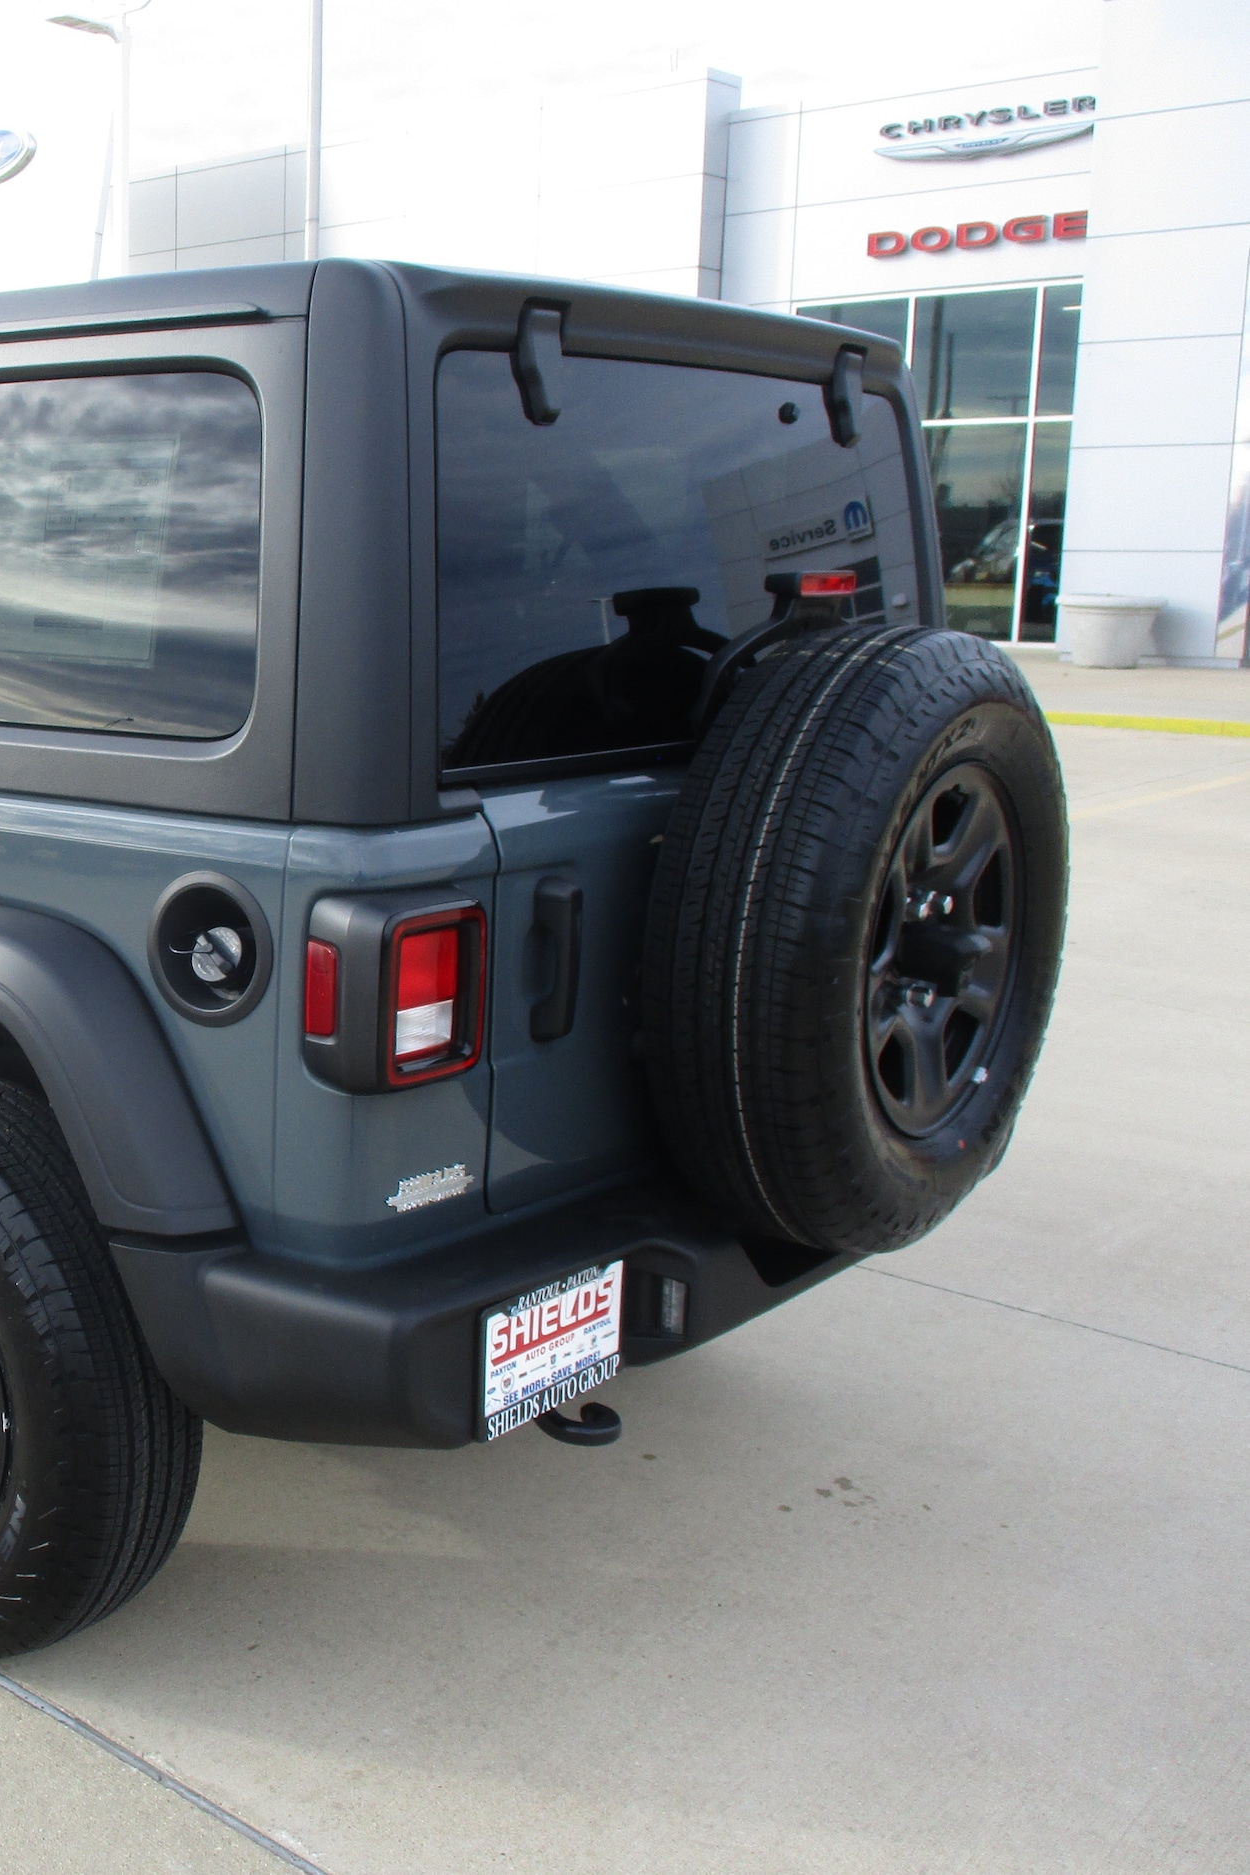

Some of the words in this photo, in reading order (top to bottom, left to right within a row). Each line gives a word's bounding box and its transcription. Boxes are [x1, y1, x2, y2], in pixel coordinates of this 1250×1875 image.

[879, 95, 1096, 139] CHRYSLER
[867, 210, 1088, 257] DODGE
[517, 1281, 560, 1310] RANTOUL
[566, 1265, 599, 1290] PAXTON
[491, 1271, 615, 1362] SHIELDS
[583, 1317, 611, 1335] RANTOUL
[525, 1346, 546, 1362] AUTO
[549, 1333, 575, 1351] GROUP
[490, 1361, 517, 1380] PAXTON
[503, 1391, 519, 1406] SEE
[521, 1377, 546, 1397] MORE
[551, 1365, 572, 1384] SAVE
[575, 1350, 601, 1369] MORE!
[487, 1394, 540, 1441] SHIELDS
[541, 1378, 577, 1414] AUTO
[579, 1354, 620, 1393] GROUP
